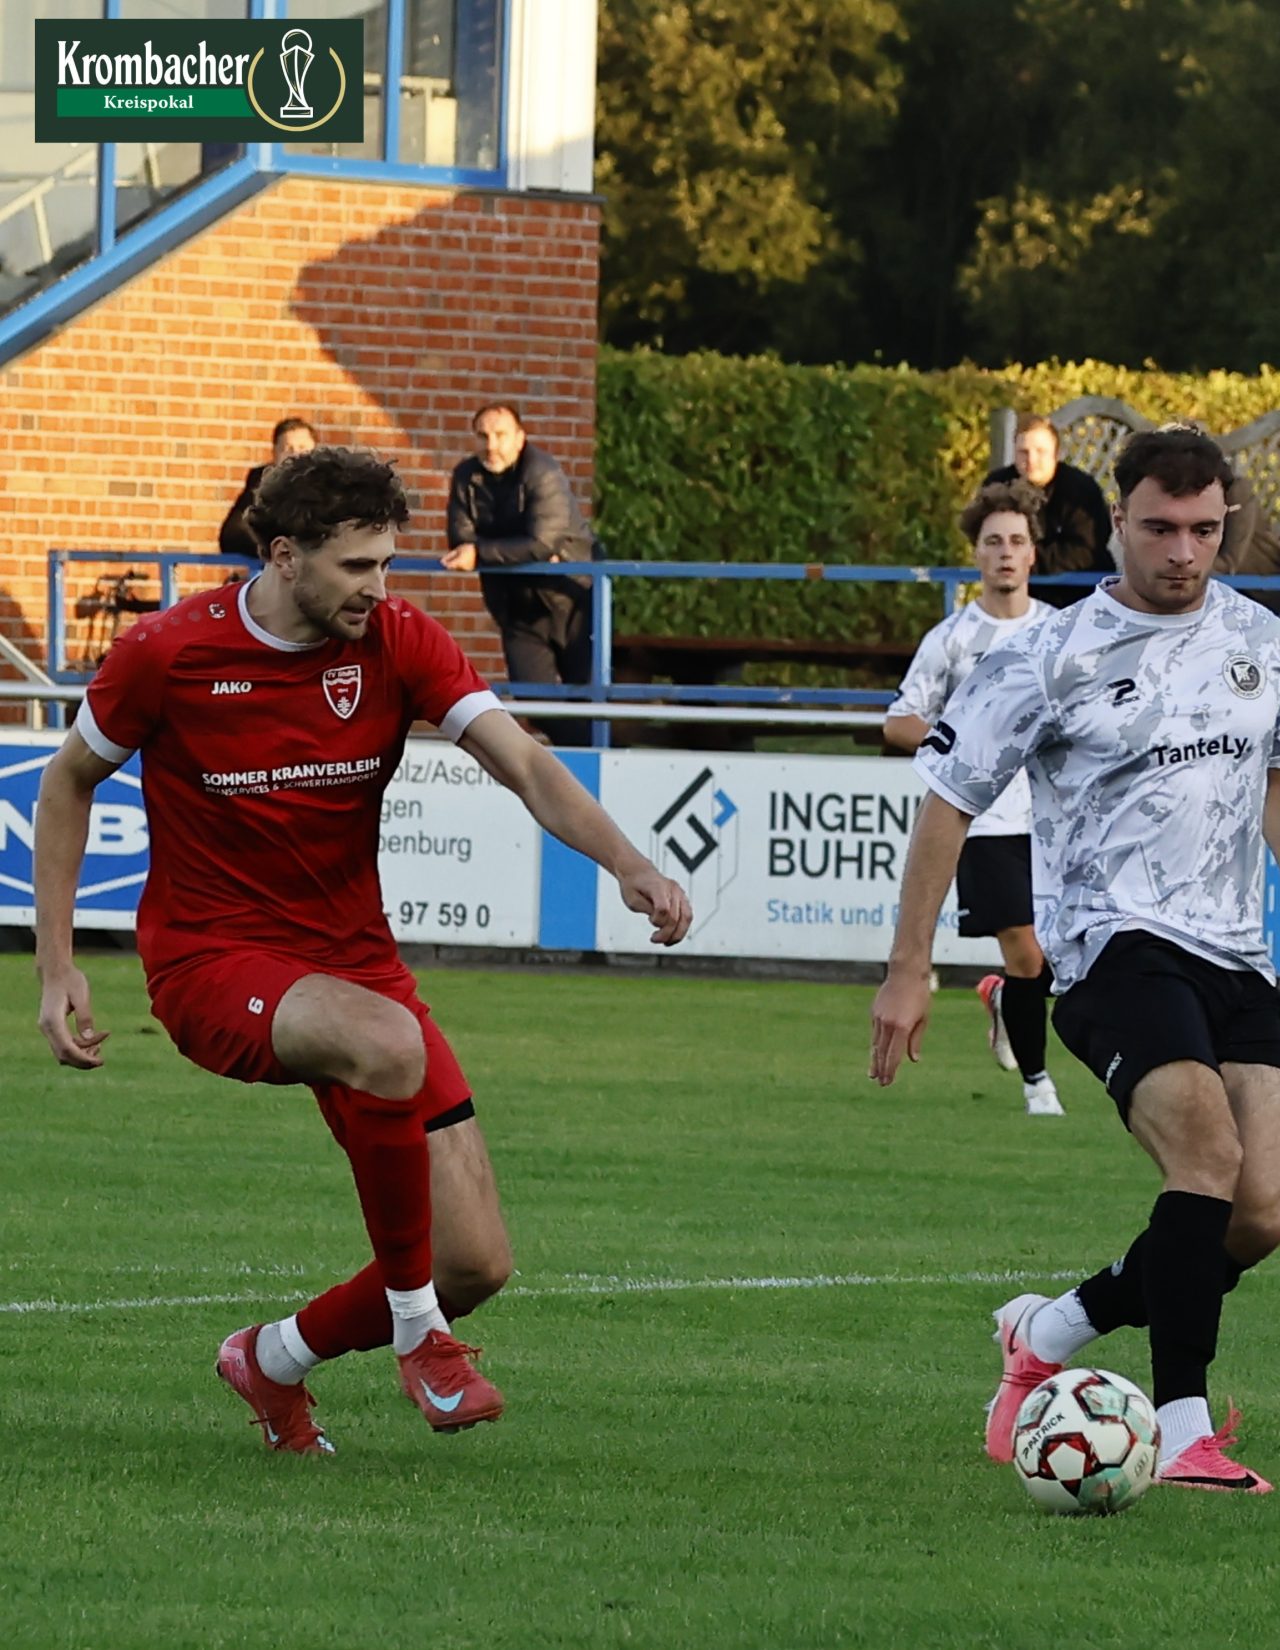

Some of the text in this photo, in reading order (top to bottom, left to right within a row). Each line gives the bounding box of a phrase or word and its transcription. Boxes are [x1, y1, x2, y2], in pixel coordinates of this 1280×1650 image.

[211, 681, 252, 695] JAKO
[1151, 735, 1248, 766] TanteLy
[202, 756, 380, 786] SOMMER KRANVERLEIH
[380, 799, 422, 824] gen
[400, 901, 429, 925] 97
[437, 902, 467, 927] 59
[476, 904, 491, 928] 0
[767, 899, 833, 924] Statik
[841, 902, 884, 927] und
[248, 996, 264, 1015] 6
[1027, 1411, 1066, 1450] PATRICK
